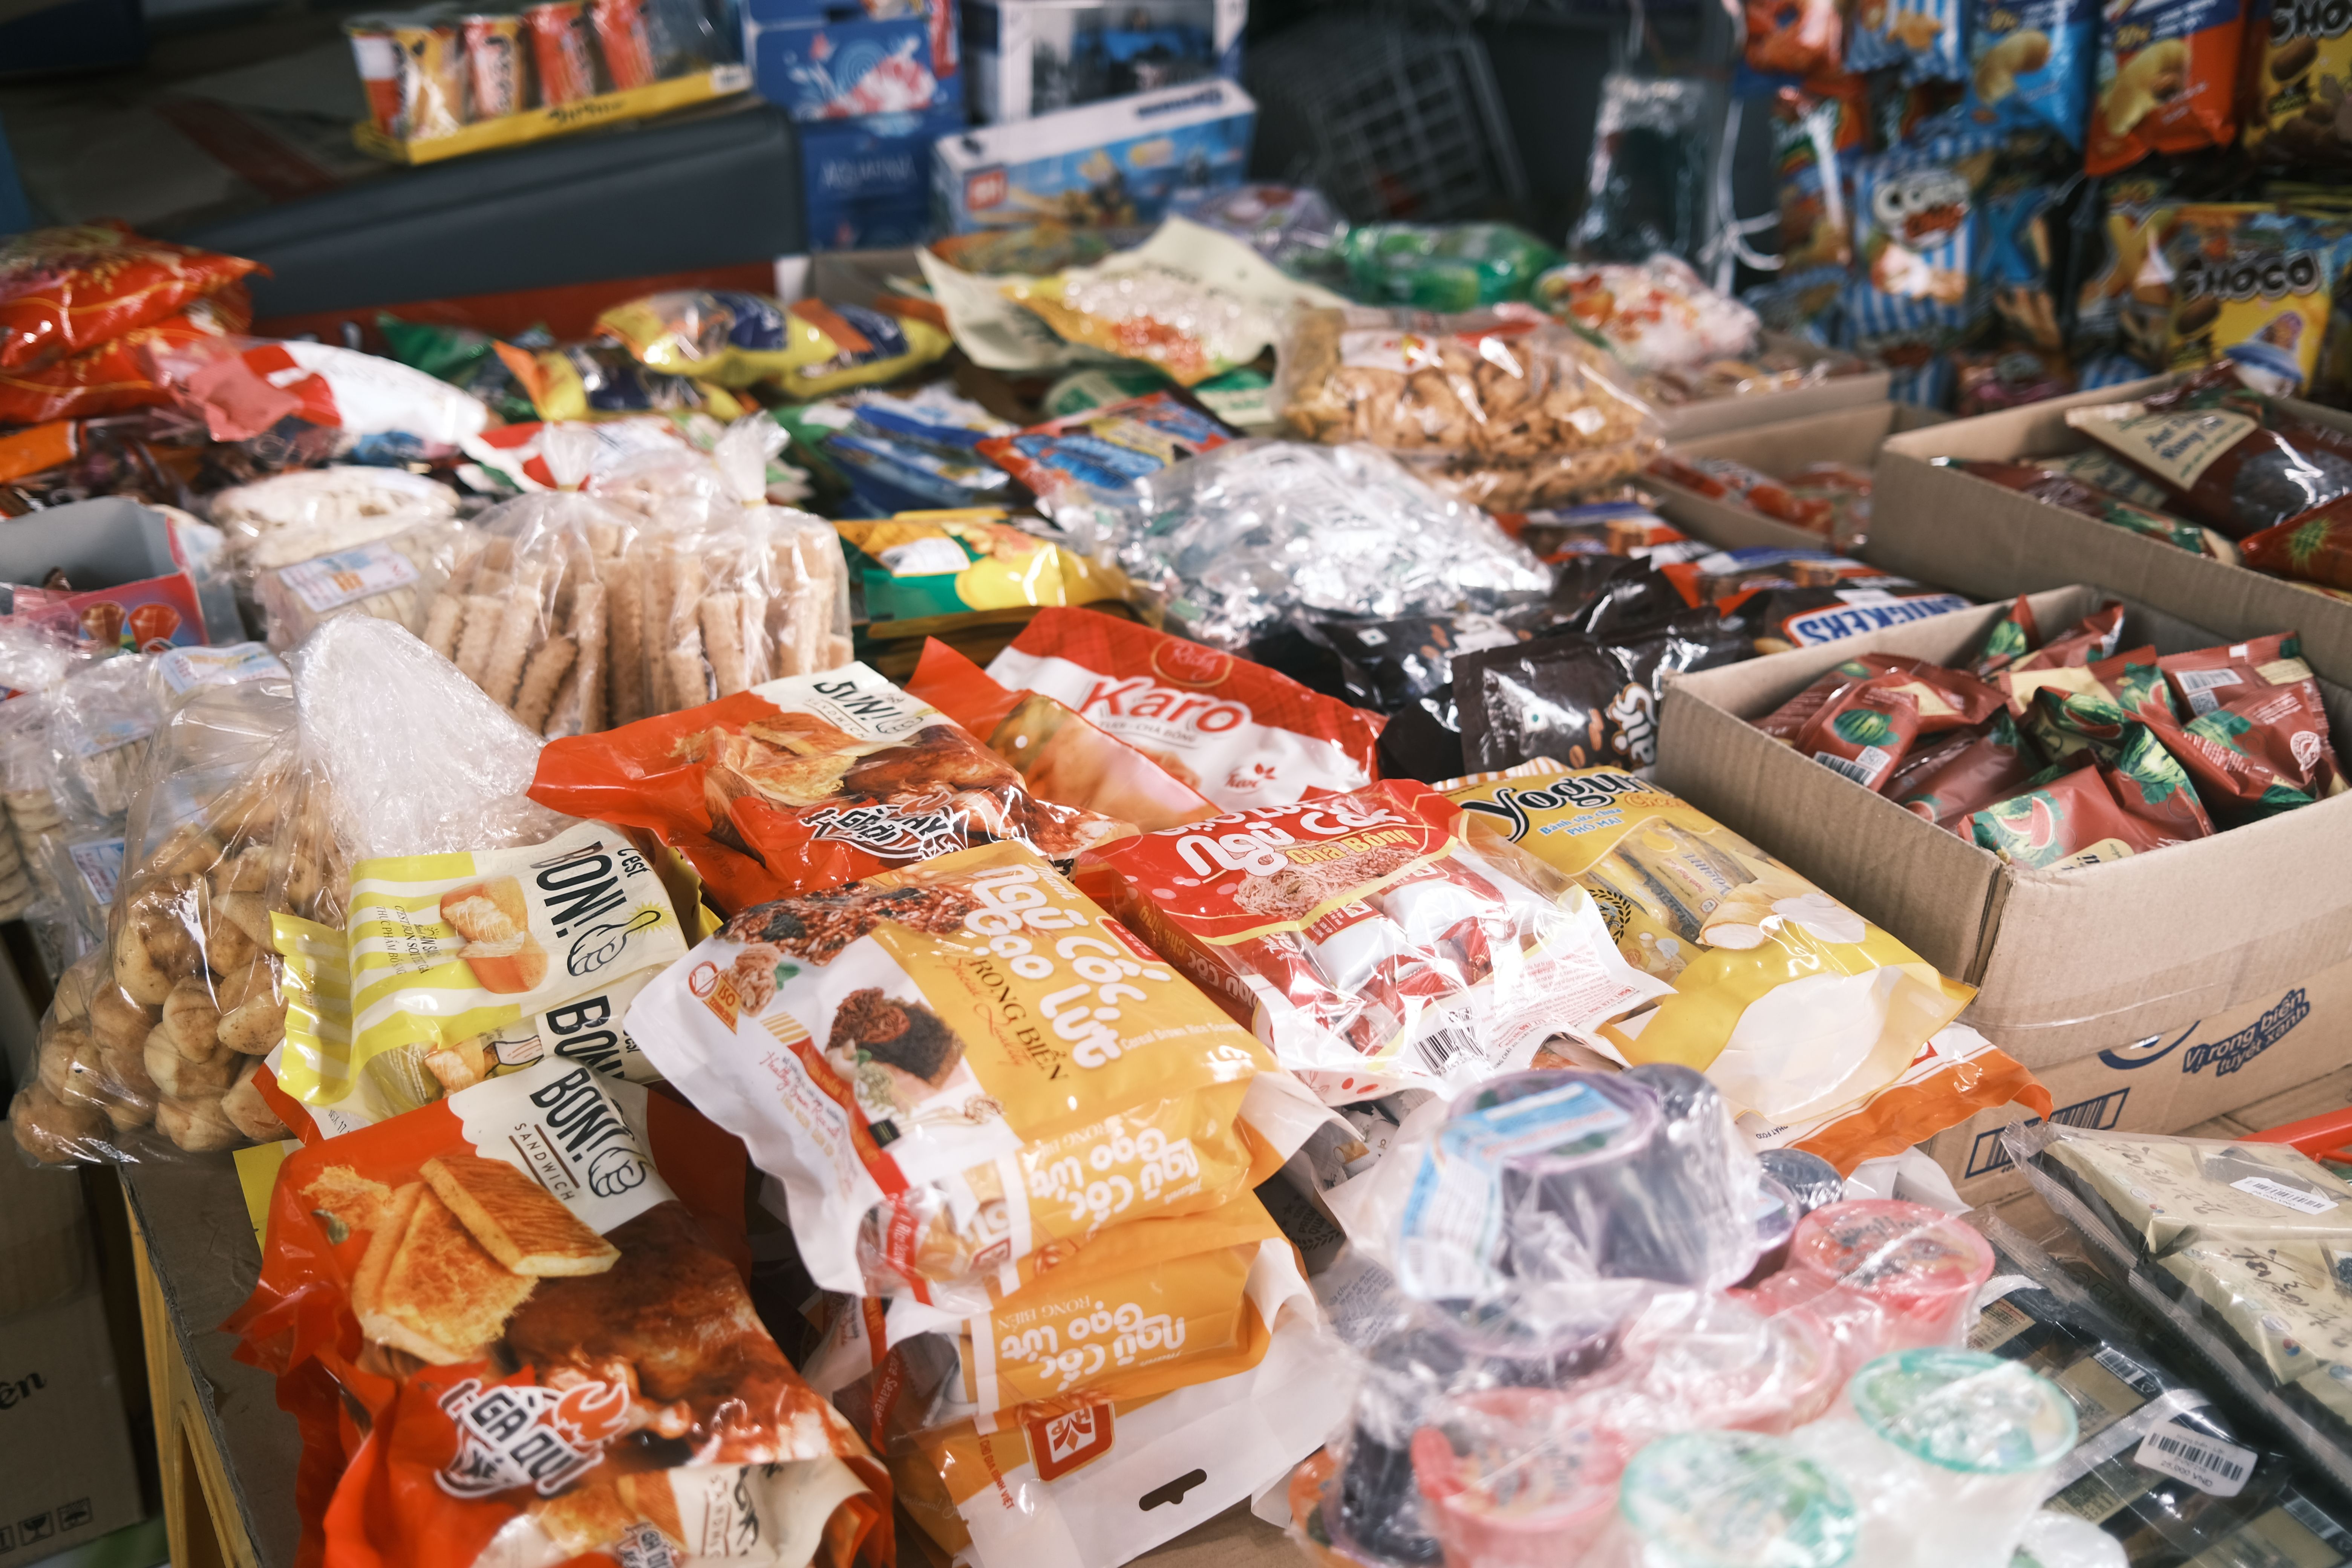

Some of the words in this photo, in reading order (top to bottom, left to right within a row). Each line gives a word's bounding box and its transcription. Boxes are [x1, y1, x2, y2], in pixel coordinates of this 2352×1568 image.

[1080, 680, 1244, 734] Karo
[1176, 821, 1296, 877] Ngũ
[1288, 842, 1349, 866] Chà
[1346, 828, 1419, 855] Bông
[1538, 819, 1571, 836] Bánh
[1597, 816, 1625, 828] MAI
[376, 906, 391, 926] THỰC
[395, 905, 410, 925] C'EST
[530, 841, 627, 939] BON!
[401, 925, 416, 941] BON
[963, 907, 1055, 979] Gạo
[971, 864, 1089, 930] Ngũ
[1055, 936, 1172, 1005] Cốc
[717, 983, 736, 1007] ISO
[969, 958, 1028, 1022] RONG
[2208, 1025, 2256, 1061] rong
[2260, 991, 2303, 1032] biển
[2265, 1004, 2308, 1044] xanh
[530, 1067, 630, 1163] BON!
[514, 1122, 576, 1201] SANDWICH
[470, 1392, 536, 1443] GÀ
[510, 1432, 573, 1480] QU
